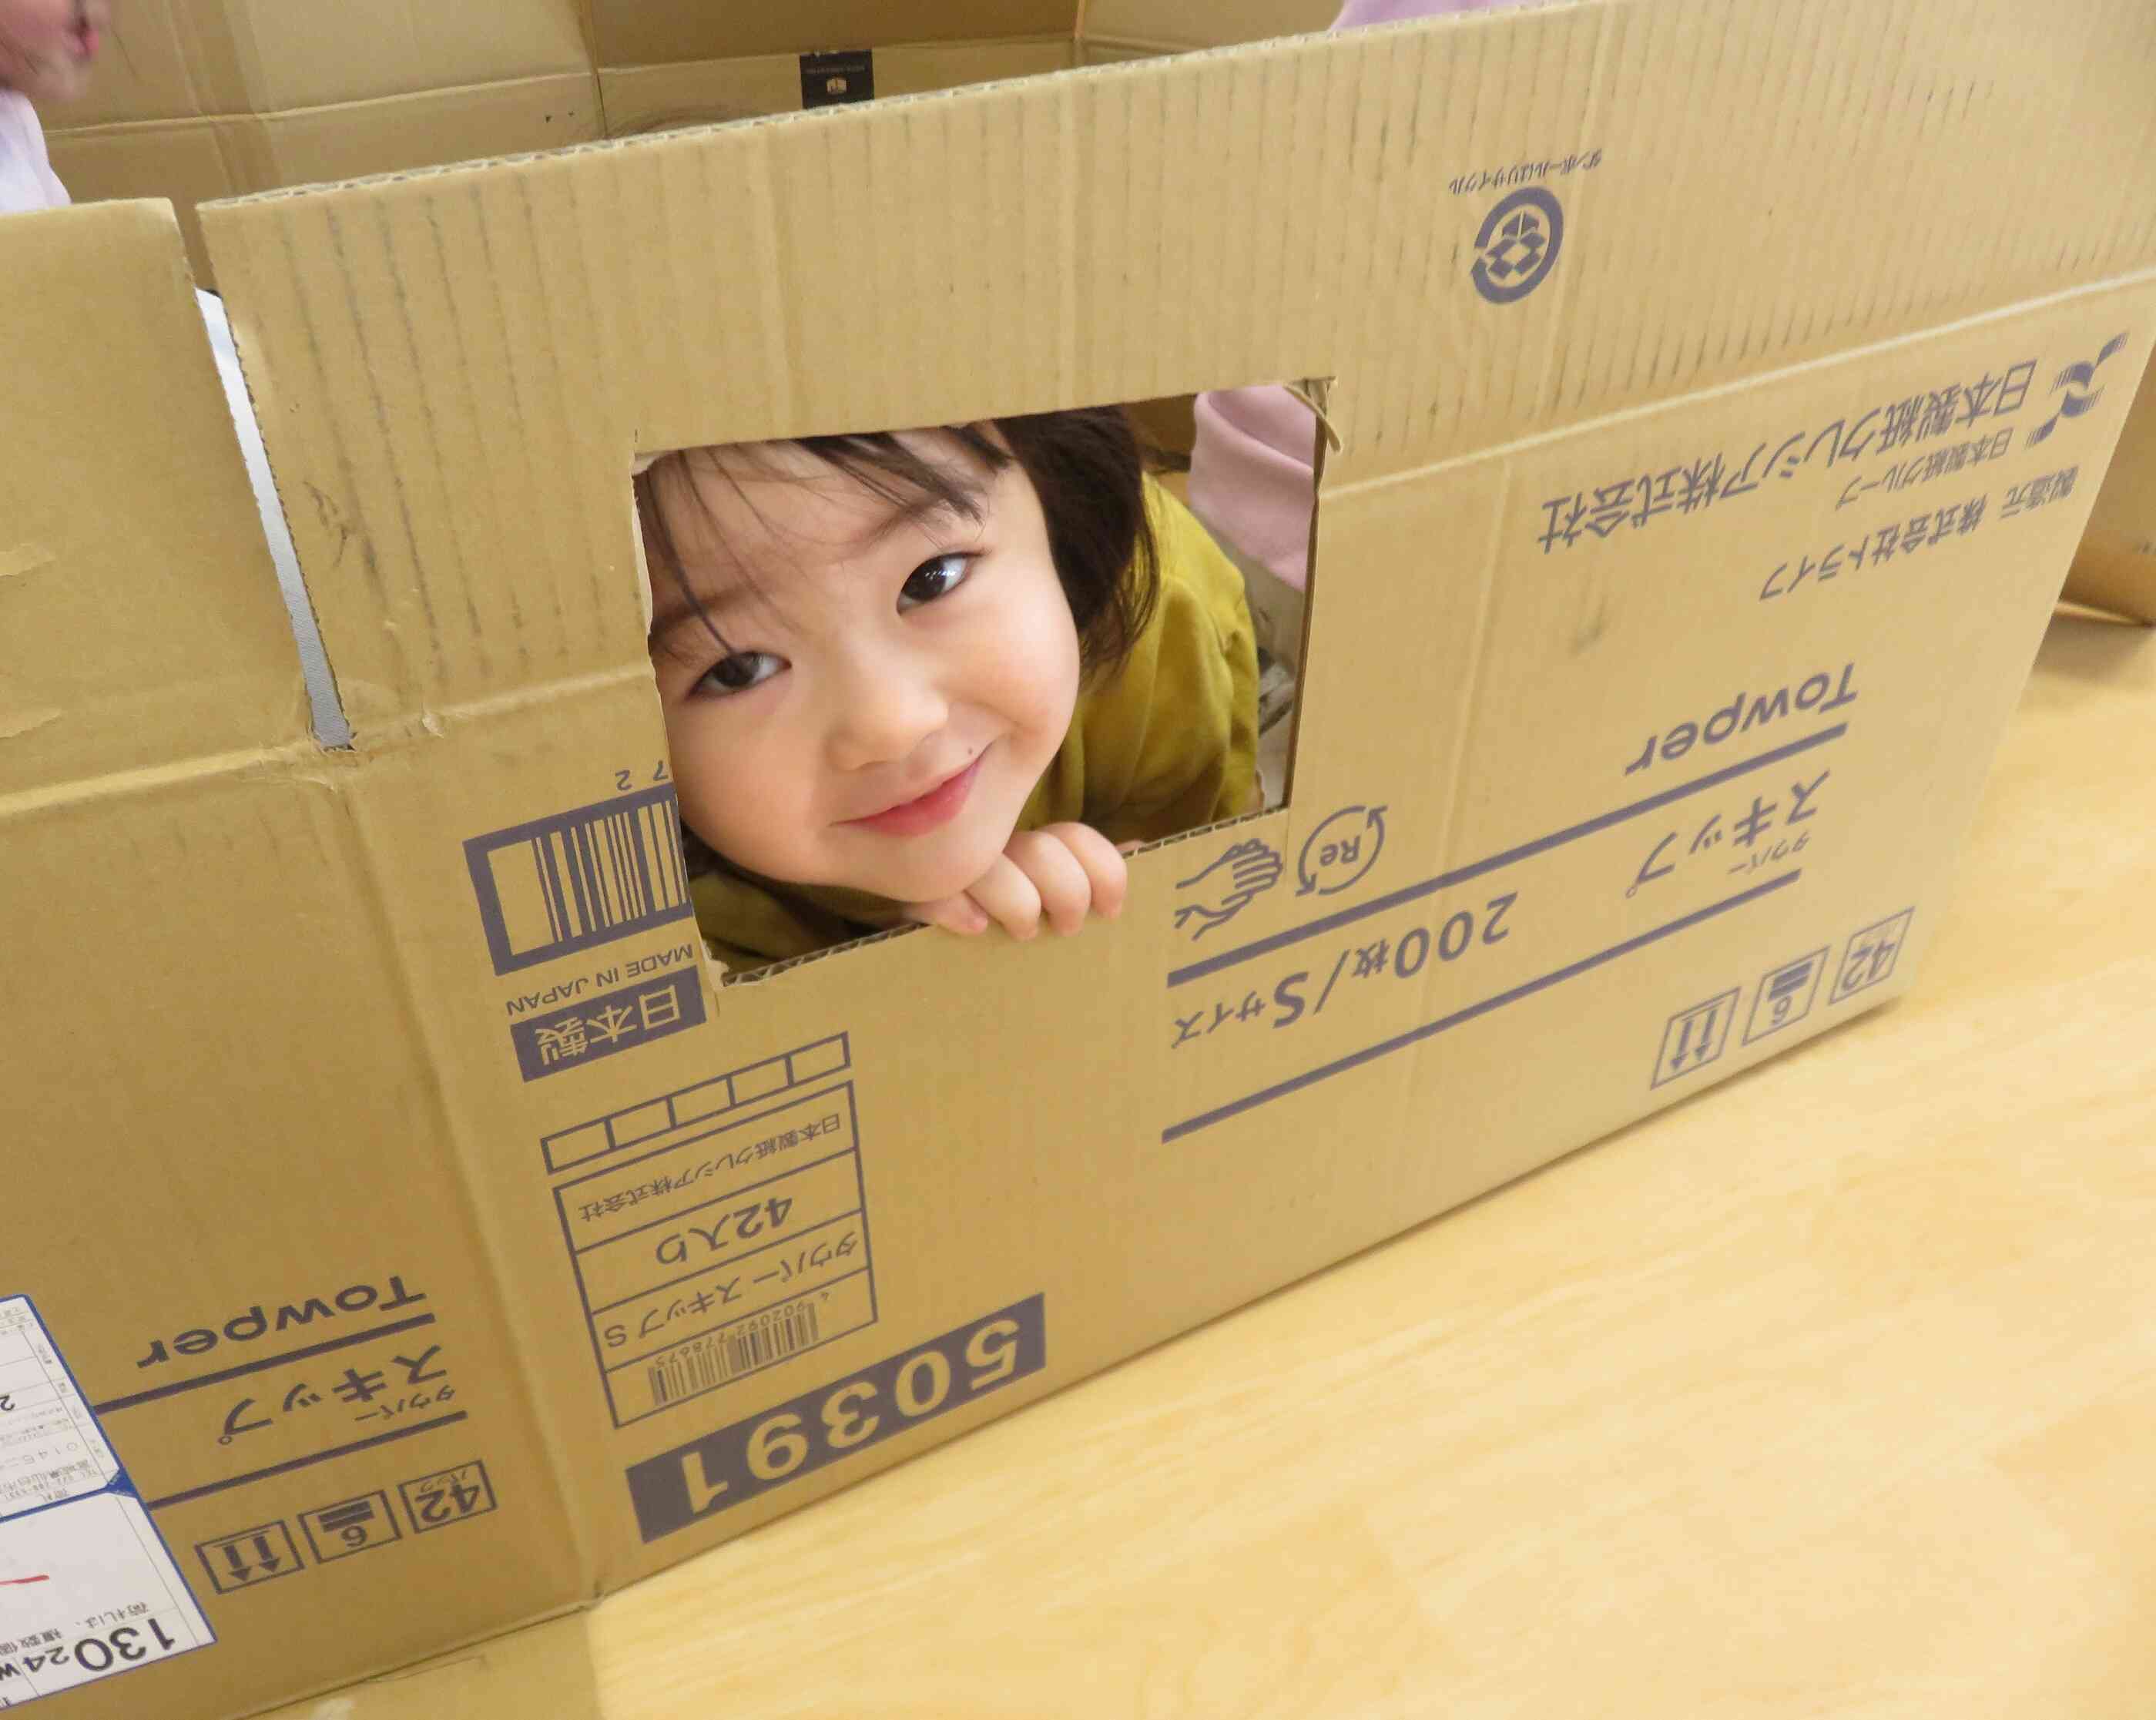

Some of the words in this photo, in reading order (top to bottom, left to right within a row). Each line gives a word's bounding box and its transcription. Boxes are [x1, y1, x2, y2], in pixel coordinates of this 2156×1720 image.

[1537, 360, 2037, 554] 日本製紙クレシア株式会社
[1835, 427, 2014, 510] 日本製紙グループ
[2000, 466, 2078, 518] 製造元
[1759, 498, 1987, 601] 株式会社トライフ
[1625, 662, 1857, 776] Towper
[1319, 839, 1360, 868] Re
[1625, 770, 1830, 899] スキップ
[595, 967, 619, 989] IN
[626, 944, 692, 977] MADE
[1842, 940, 1895, 991] 42
[506, 977, 588, 1015] JAPAN
[1772, 997, 1792, 1024] 6
[535, 985, 680, 1065] 日本製
[578, 1114, 840, 1222] 日本製紙クレシア株式会社
[654, 1197, 793, 1264] 42入り
[136, 1276, 427, 1370] Towper
[603, 1325, 627, 1348] S
[218, 1345, 447, 1446] スキップ
[681, 1319, 1021, 1514] 50391
[415, 1484, 481, 1524] 42
[340, 1526, 367, 1547] 6
[22, 1646, 69, 1672] 24
[75, 1618, 176, 1672] 130
